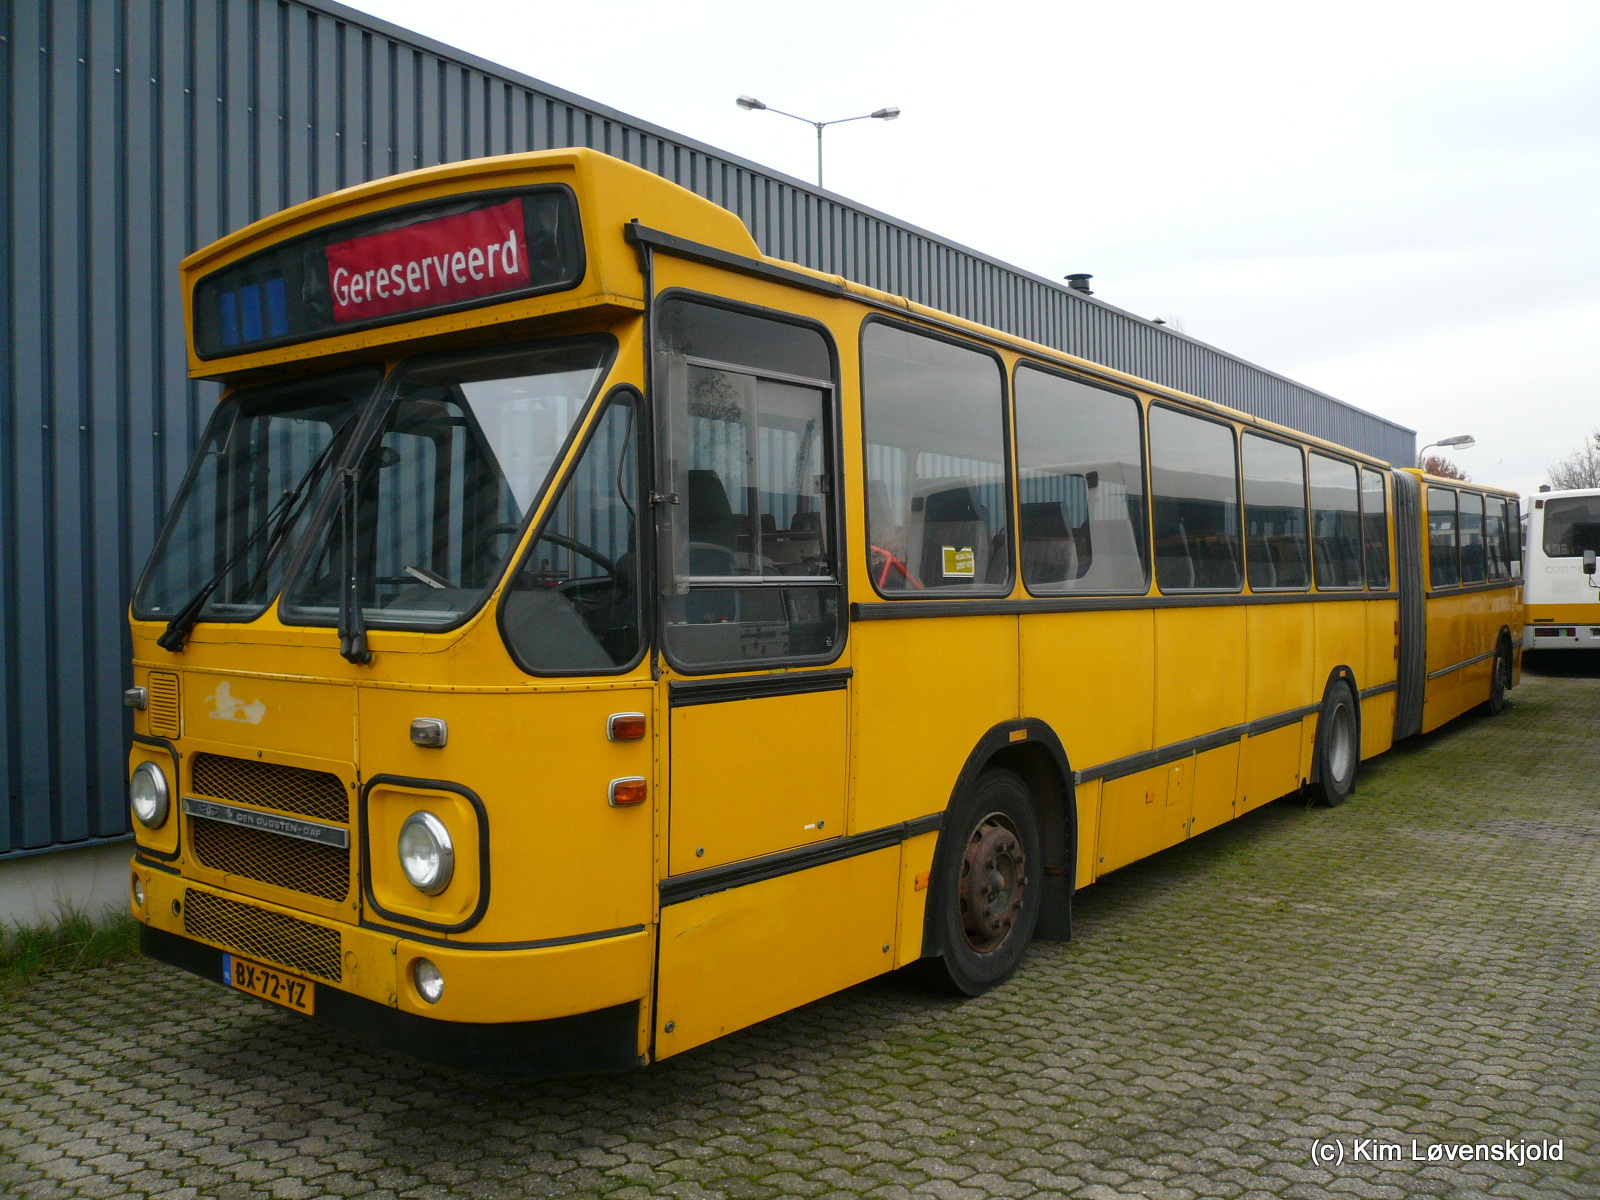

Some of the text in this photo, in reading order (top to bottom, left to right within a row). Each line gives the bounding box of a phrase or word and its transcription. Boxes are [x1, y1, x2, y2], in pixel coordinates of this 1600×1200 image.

[332, 228, 519, 307] Gereserveerd
[236, 813, 254, 824] DEN
[235, 961, 306, 1009] BX-72-YZ
